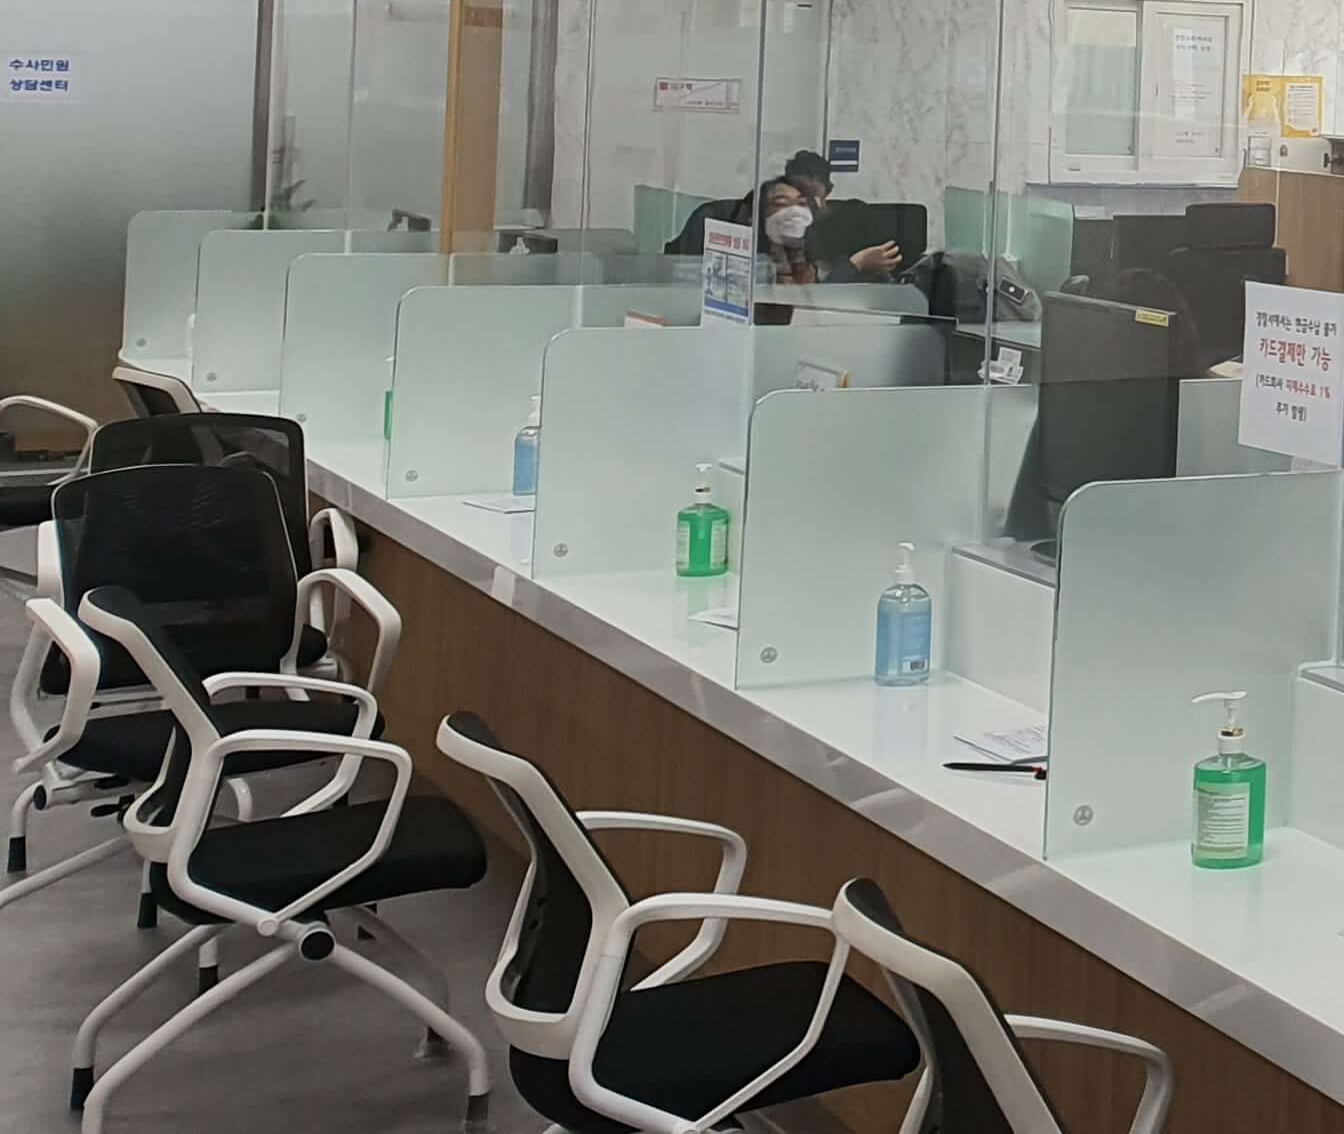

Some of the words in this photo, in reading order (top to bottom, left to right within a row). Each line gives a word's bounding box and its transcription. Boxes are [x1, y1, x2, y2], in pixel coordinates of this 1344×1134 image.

[9, 79, 69, 92] 상담센터
[1259, 337, 1306, 366] 카드결제만
[1311, 346, 1332, 371] 가능
